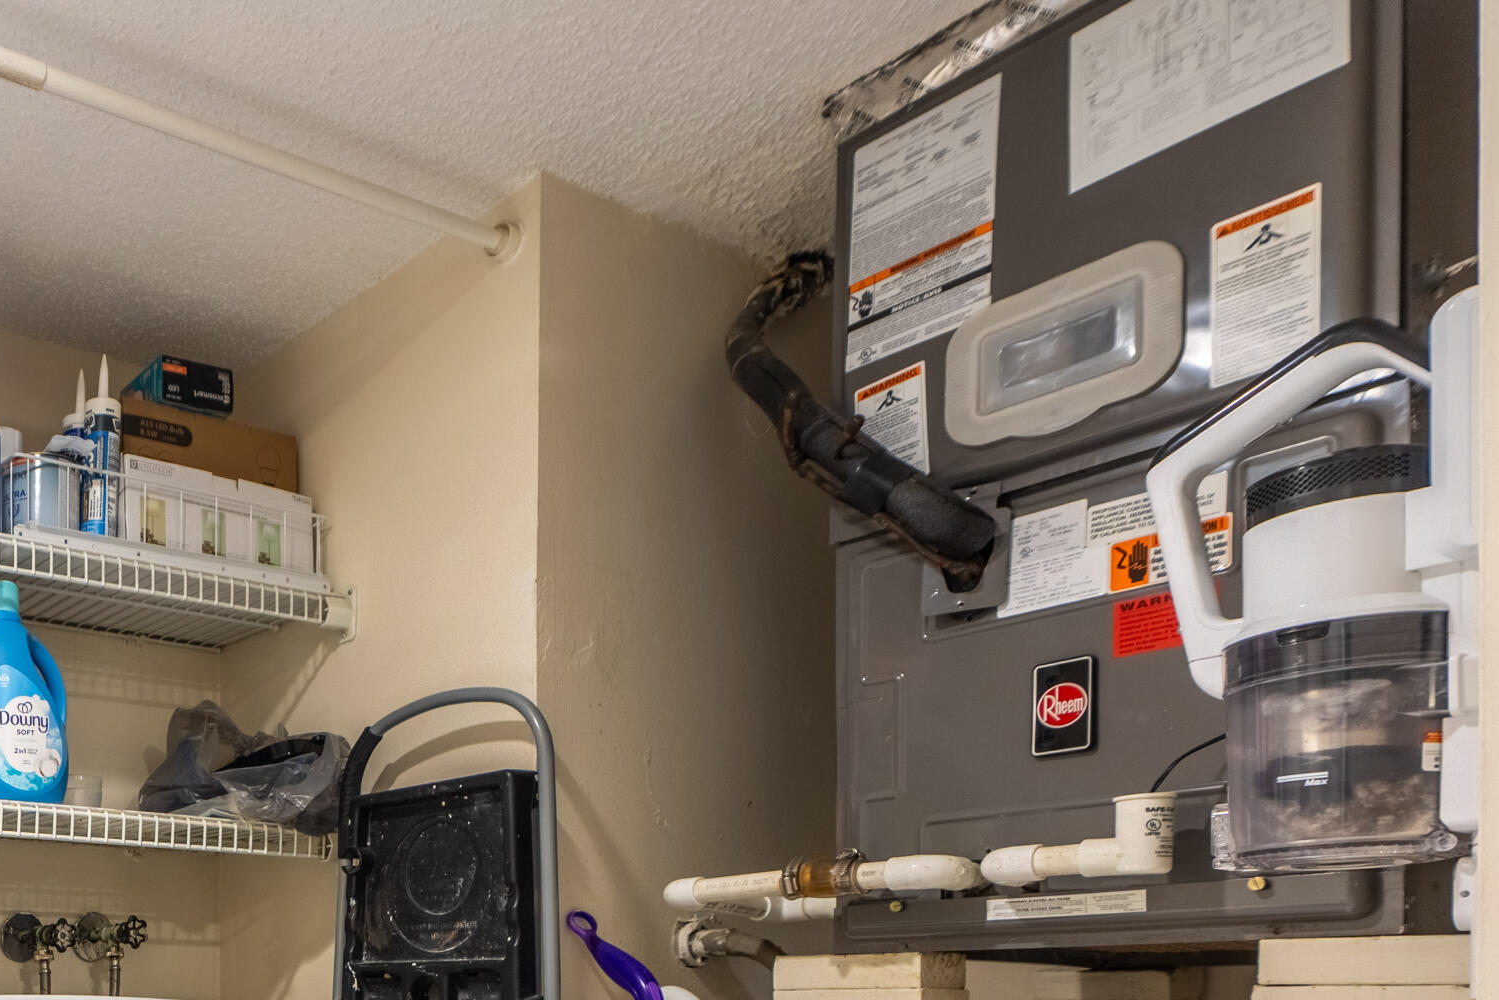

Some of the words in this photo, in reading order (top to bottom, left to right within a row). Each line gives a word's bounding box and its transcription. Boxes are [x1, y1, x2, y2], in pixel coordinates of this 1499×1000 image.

[869, 367, 917, 395] WARNING
[1042, 685, 1084, 722] Rheem
[0, 710, 49, 734] Downy
[1304, 778, 1329, 787] Max
